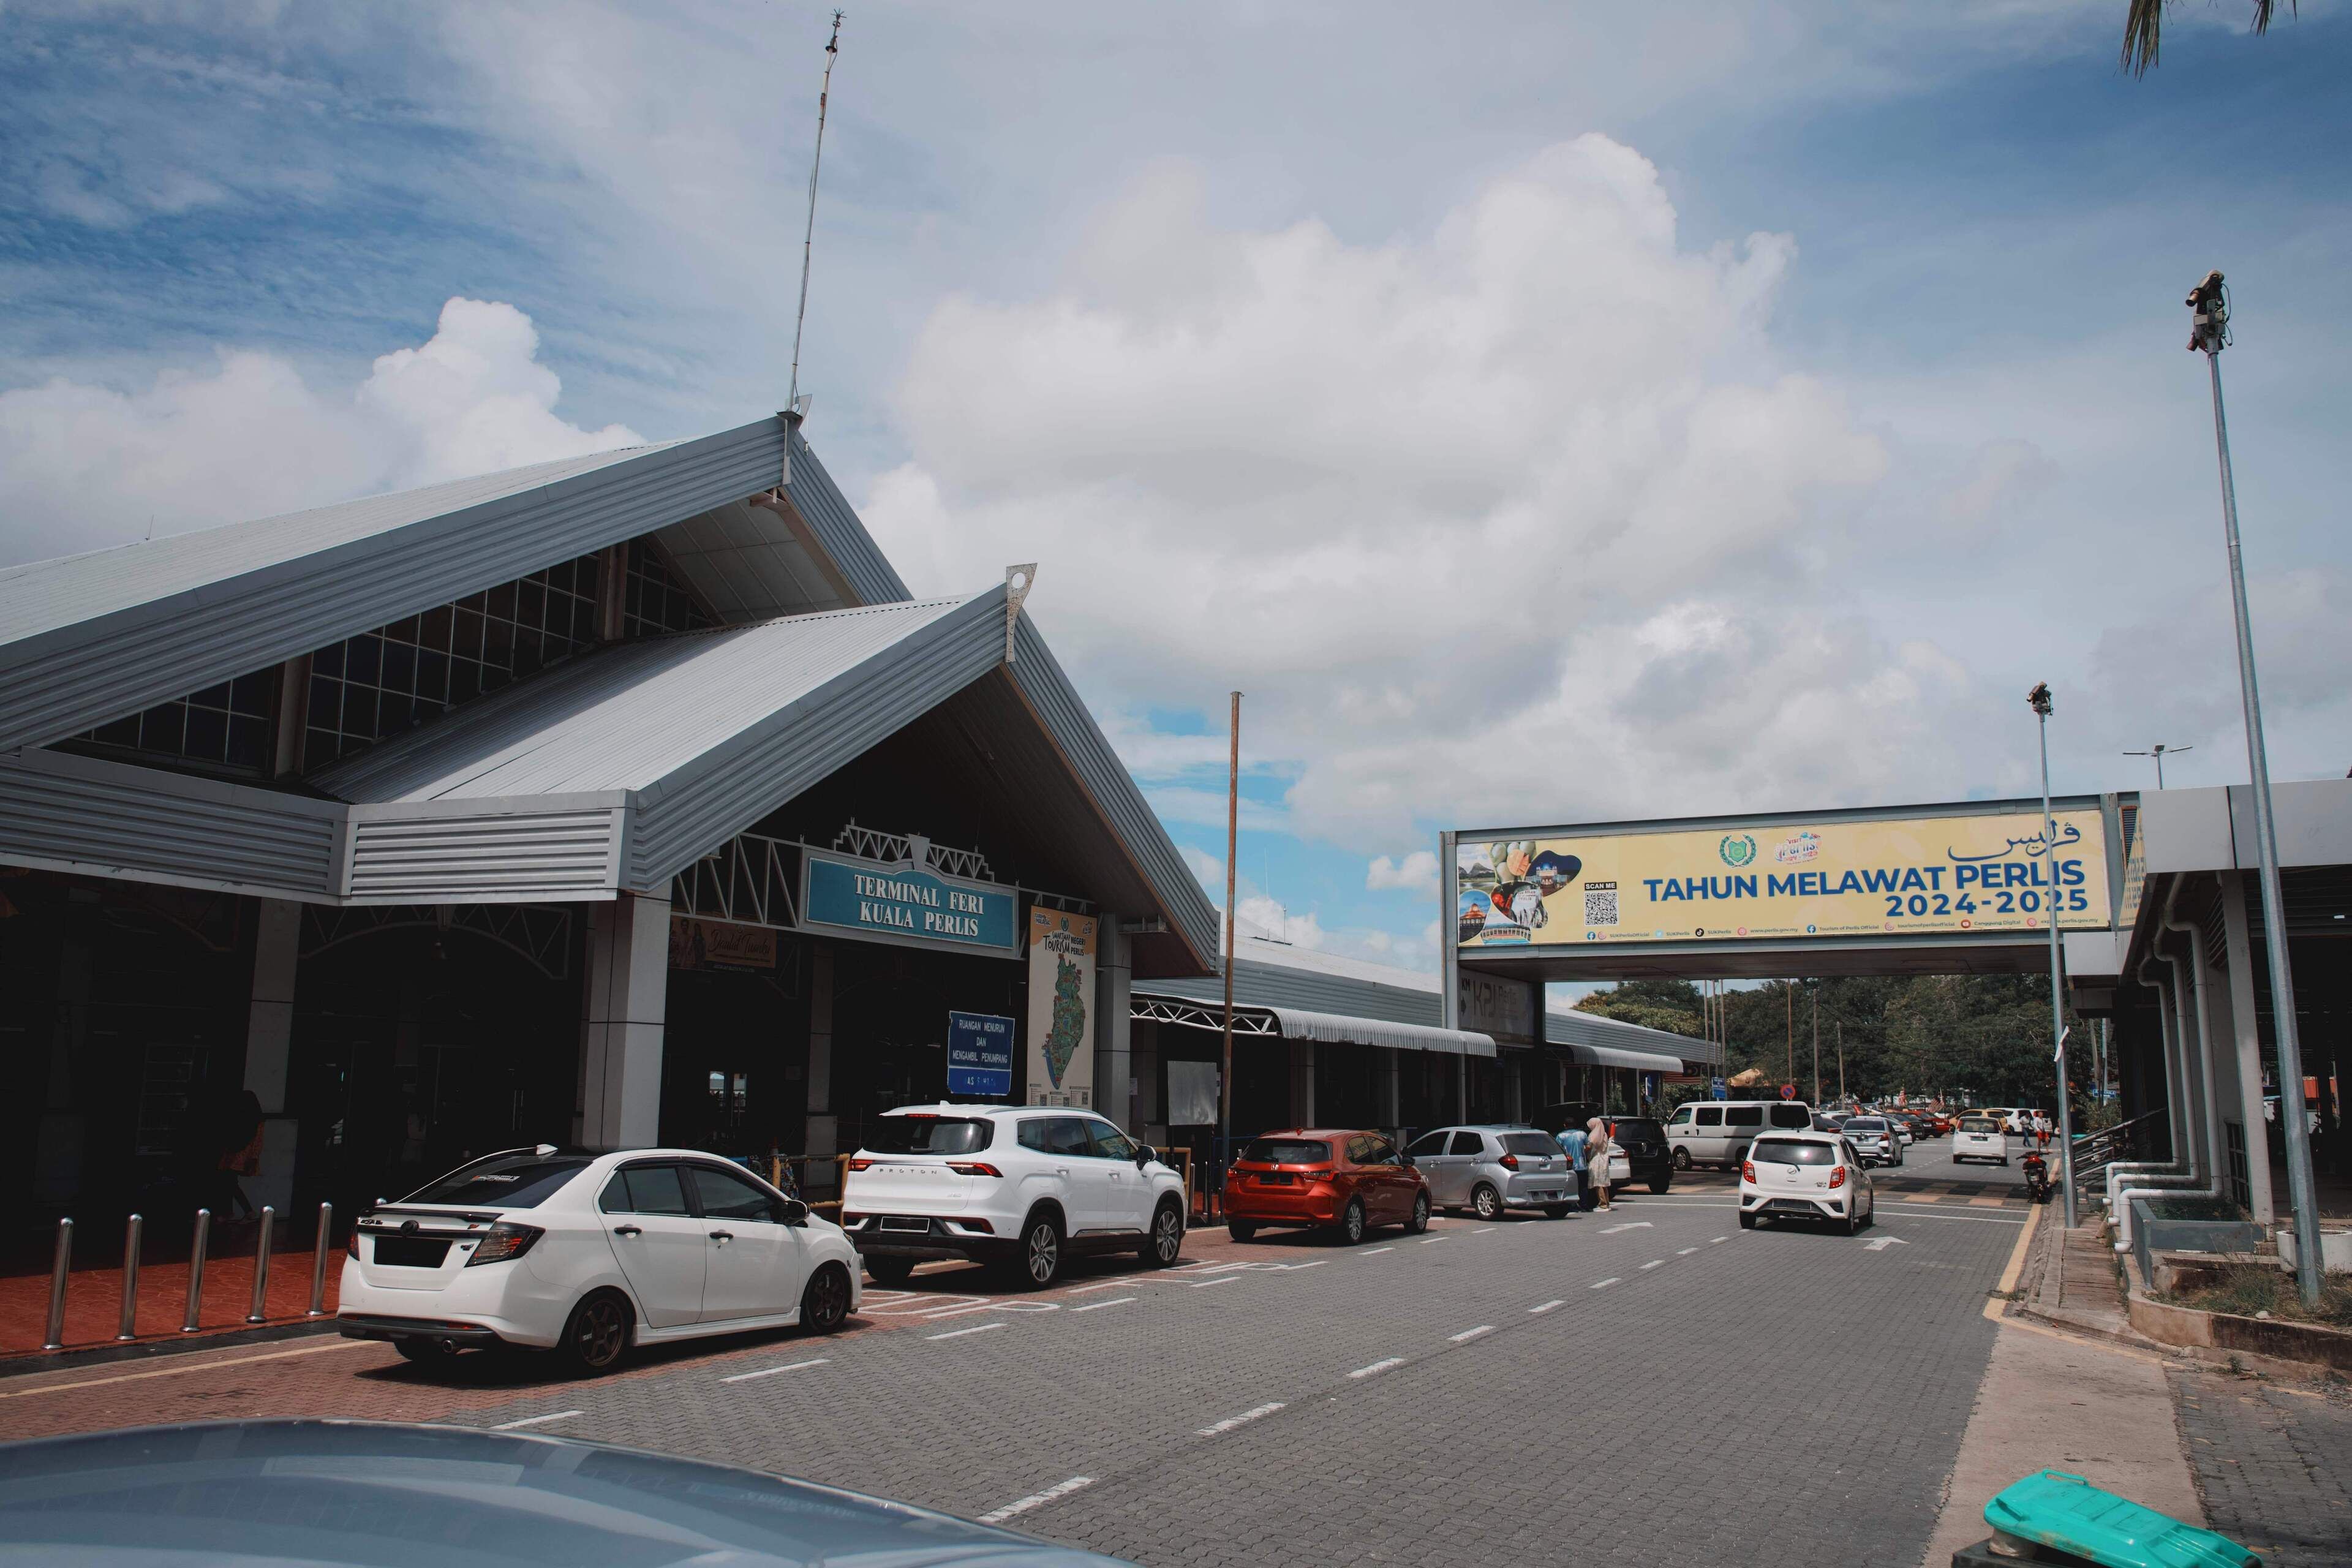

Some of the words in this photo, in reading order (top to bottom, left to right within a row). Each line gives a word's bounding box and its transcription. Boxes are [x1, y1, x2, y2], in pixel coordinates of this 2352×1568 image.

[1643, 875, 1758, 902] TAHUN
[1767, 866, 1947, 897] MELAWAT
[1955, 859, 2086, 889] PERLIS
[854, 874, 940, 907] TERMINAL
[949, 891, 984, 914] FERI
[1885, 889, 2088, 917] 2024-2025
[859, 901, 914, 928] KUALA
[924, 911, 979, 937] PERLIS
[741, 933, 771, 954] Tuanku
[1071, 937, 1086, 946] NEGERI
[1071, 947, 1084, 956] PERLIS
[1461, 978, 1470, 991] KM
[959, 1019, 981, 1031] RUANGAN
[984, 1022, 1005, 1034] MENURUN
[976, 1036, 986, 1047] DAN
[952, 1050, 978, 1061] MENGAMBIL
[981, 1052, 1008, 1064] PENUMPANG
